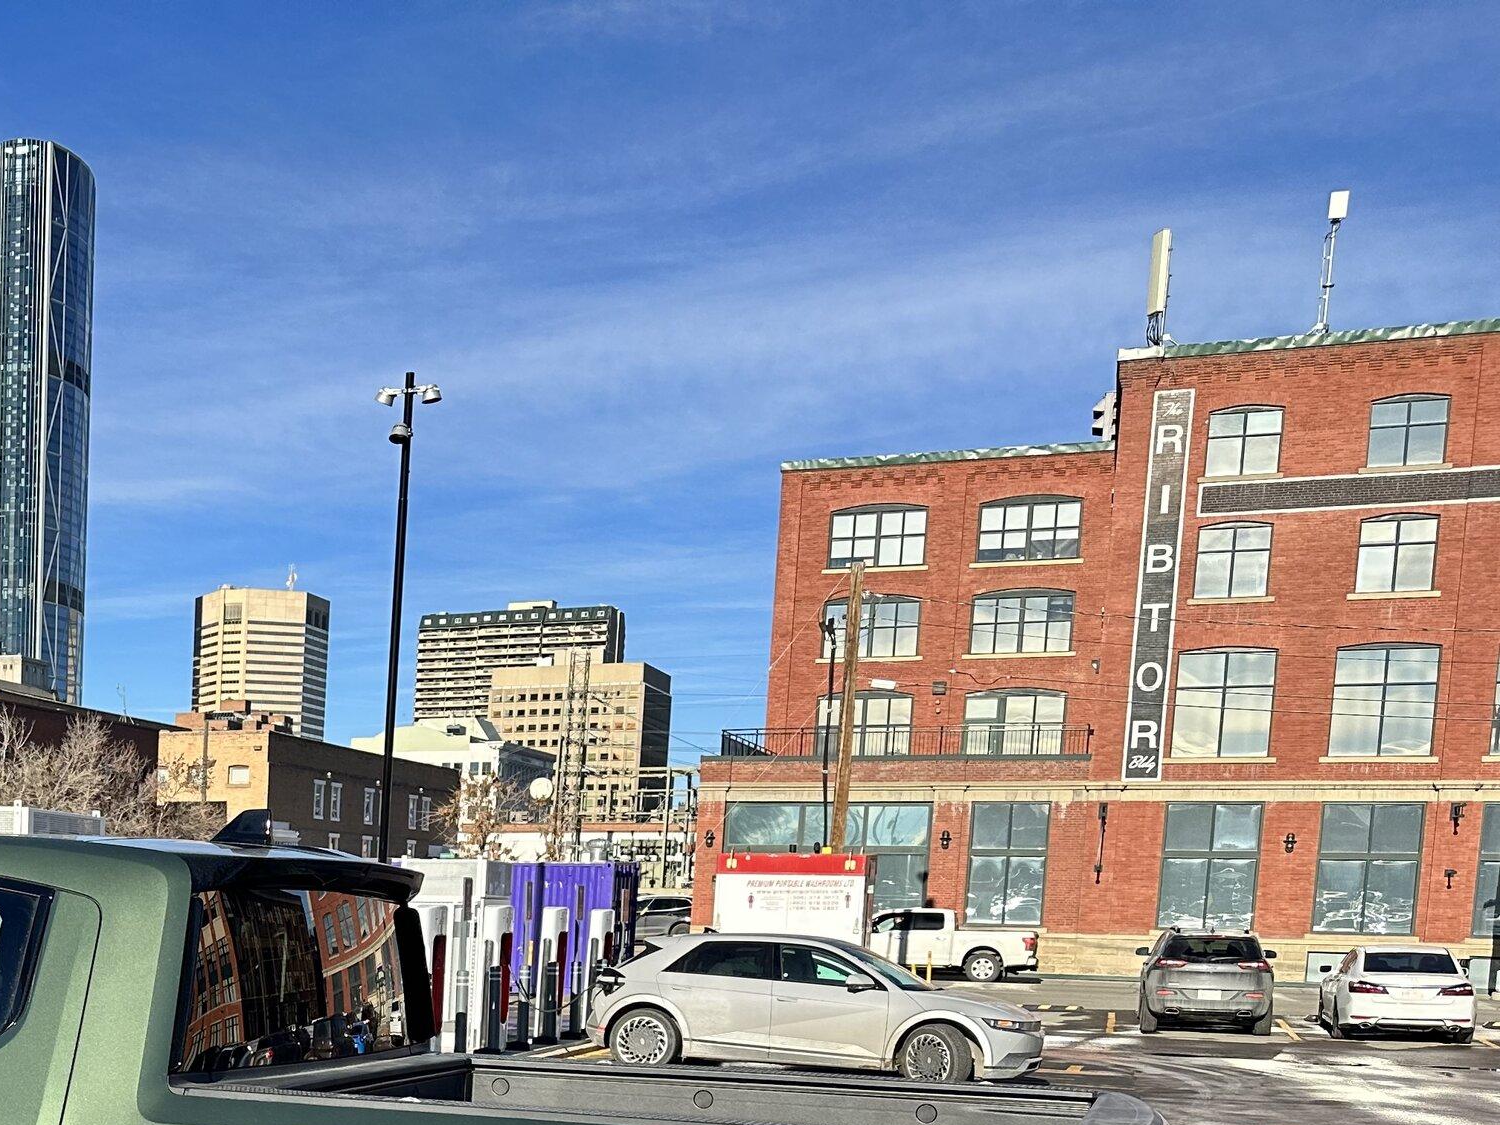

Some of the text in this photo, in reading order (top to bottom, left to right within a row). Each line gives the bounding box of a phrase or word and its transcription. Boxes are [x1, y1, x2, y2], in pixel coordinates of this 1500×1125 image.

[1162, 402, 1184, 417] The
[1130, 424, 1184, 749] RIBTOR
[1128, 755, 1156, 774] Bldg
[746, 879, 855, 888] PREMIUM PORTABLE WASHROOMS LTD
